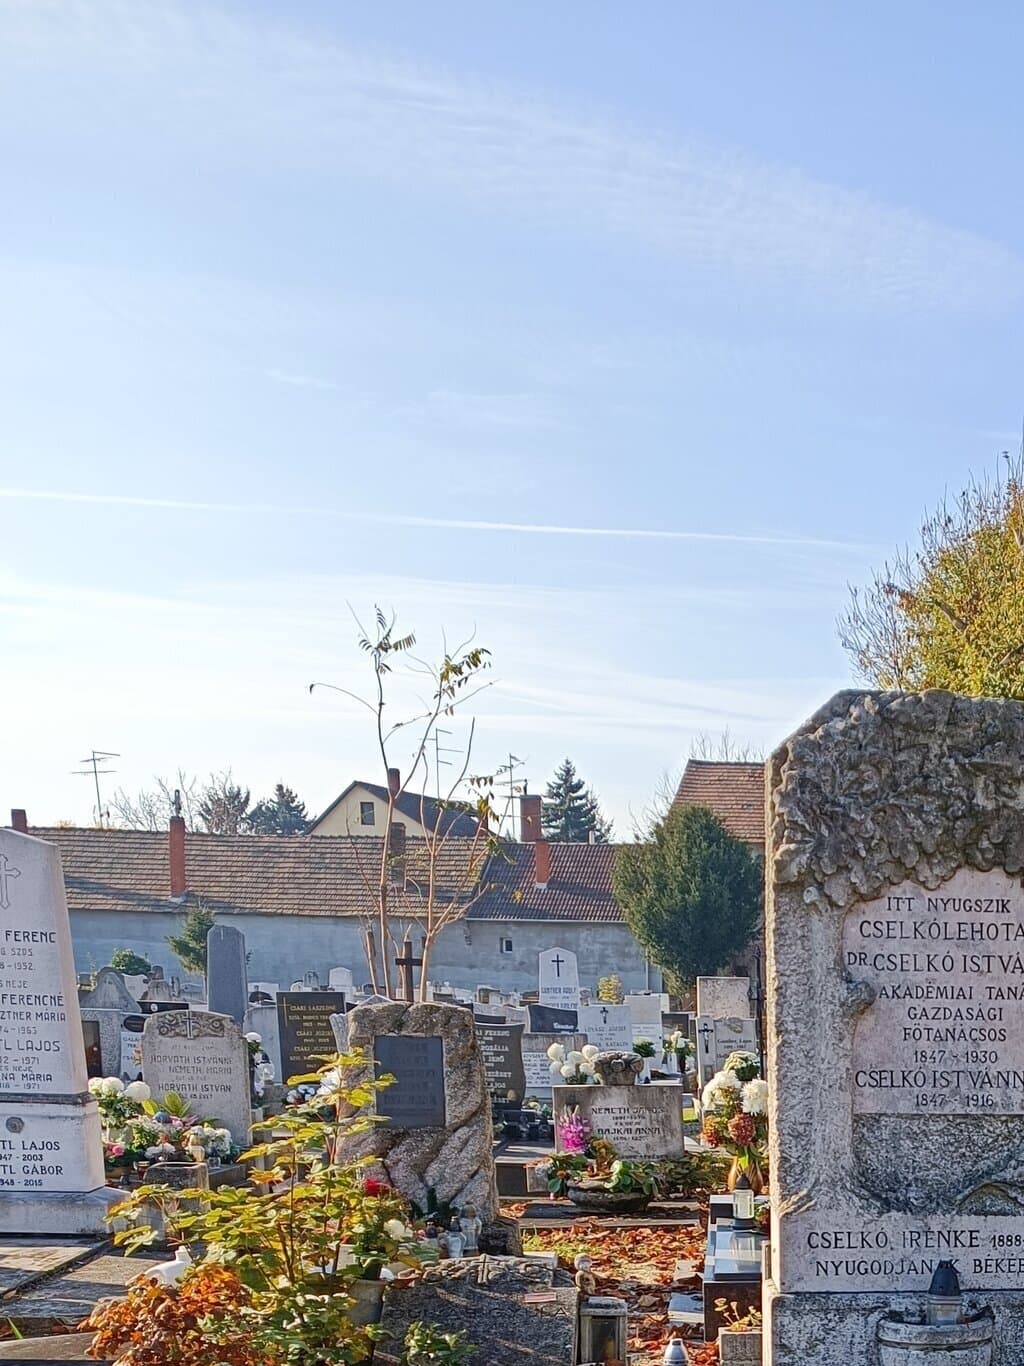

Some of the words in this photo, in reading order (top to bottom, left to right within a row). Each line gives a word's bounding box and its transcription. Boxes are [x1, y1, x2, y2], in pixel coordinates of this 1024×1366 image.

[887, 896, 915, 912] ITT
[927, 898, 1011, 913] NYUGSZIK
[5, 930, 57, 943] FERENC
[878, 981, 973, 1000] AKADÉMIAI
[1, 991, 64, 1006] FERENCNÉ
[35, 1008, 66, 1021] MÁRIA
[907, 1003, 1003, 1021] GAZDASÁGI
[17, 1039, 60, 1051] LAJOS
[914, 1050, 946, 1064] 1847
[965, 1050, 998, 1064] 1930
[855, 1066, 926, 1088] CSELKÓ
[965, 1094, 994, 1107] 1916
[22, 1140, 61, 1150] LAJOS
[22, 1153, 43, 1161] 2003
[22, 1163, 63, 1175] GÁBOR
[807, 1227, 888, 1249] CSELKÓ
[902, 1227, 981, 1249] IRÉNKE
[815, 1258, 961, 1276] NYUGODJANK
